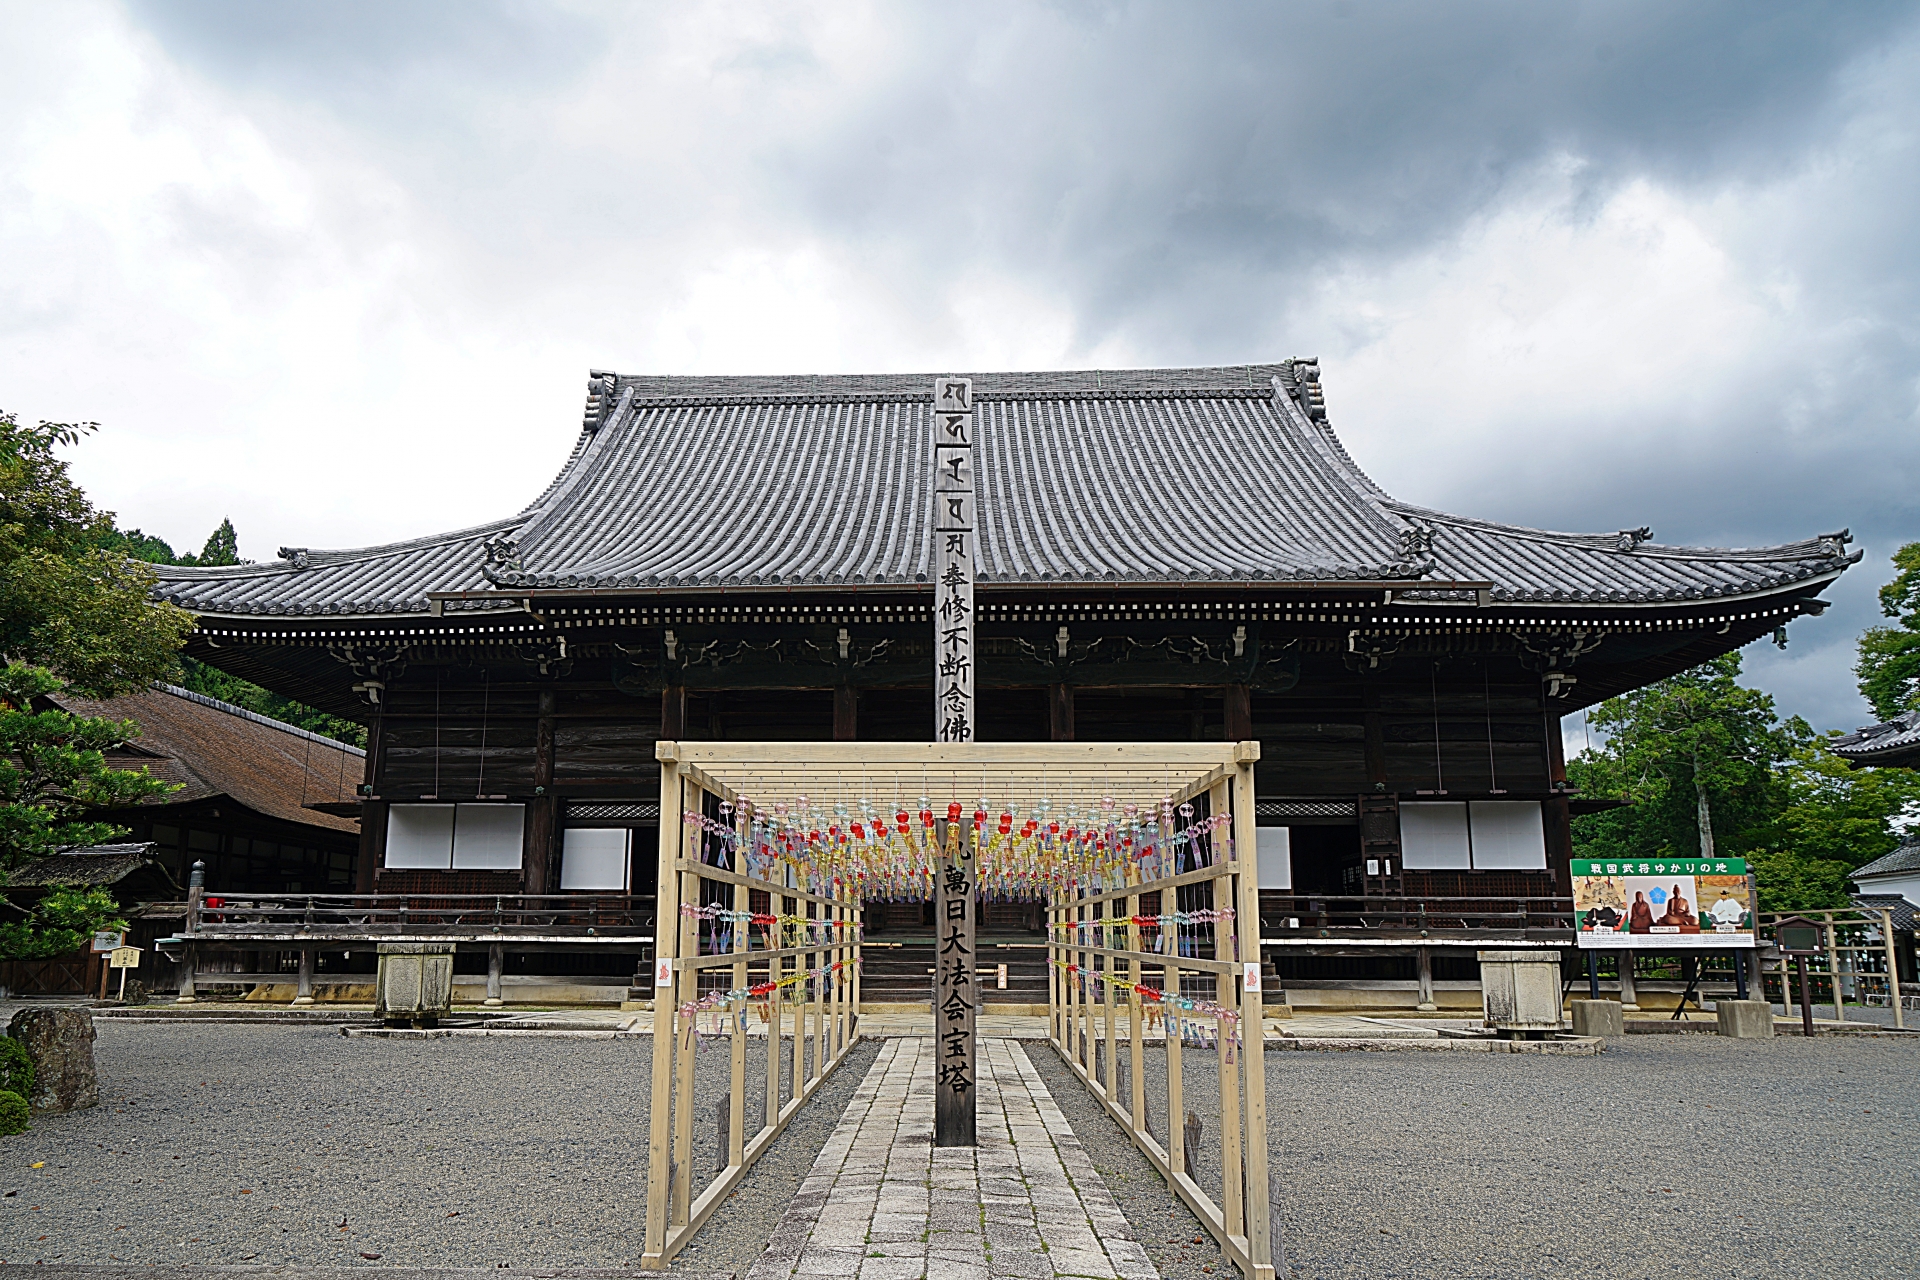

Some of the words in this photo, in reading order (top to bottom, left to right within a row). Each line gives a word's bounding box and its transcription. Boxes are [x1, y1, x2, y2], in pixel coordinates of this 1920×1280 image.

[939, 562, 971, 742] 奉修不断念佛
[1590, 862, 1728, 874] 戦国武将ゆかりの地
